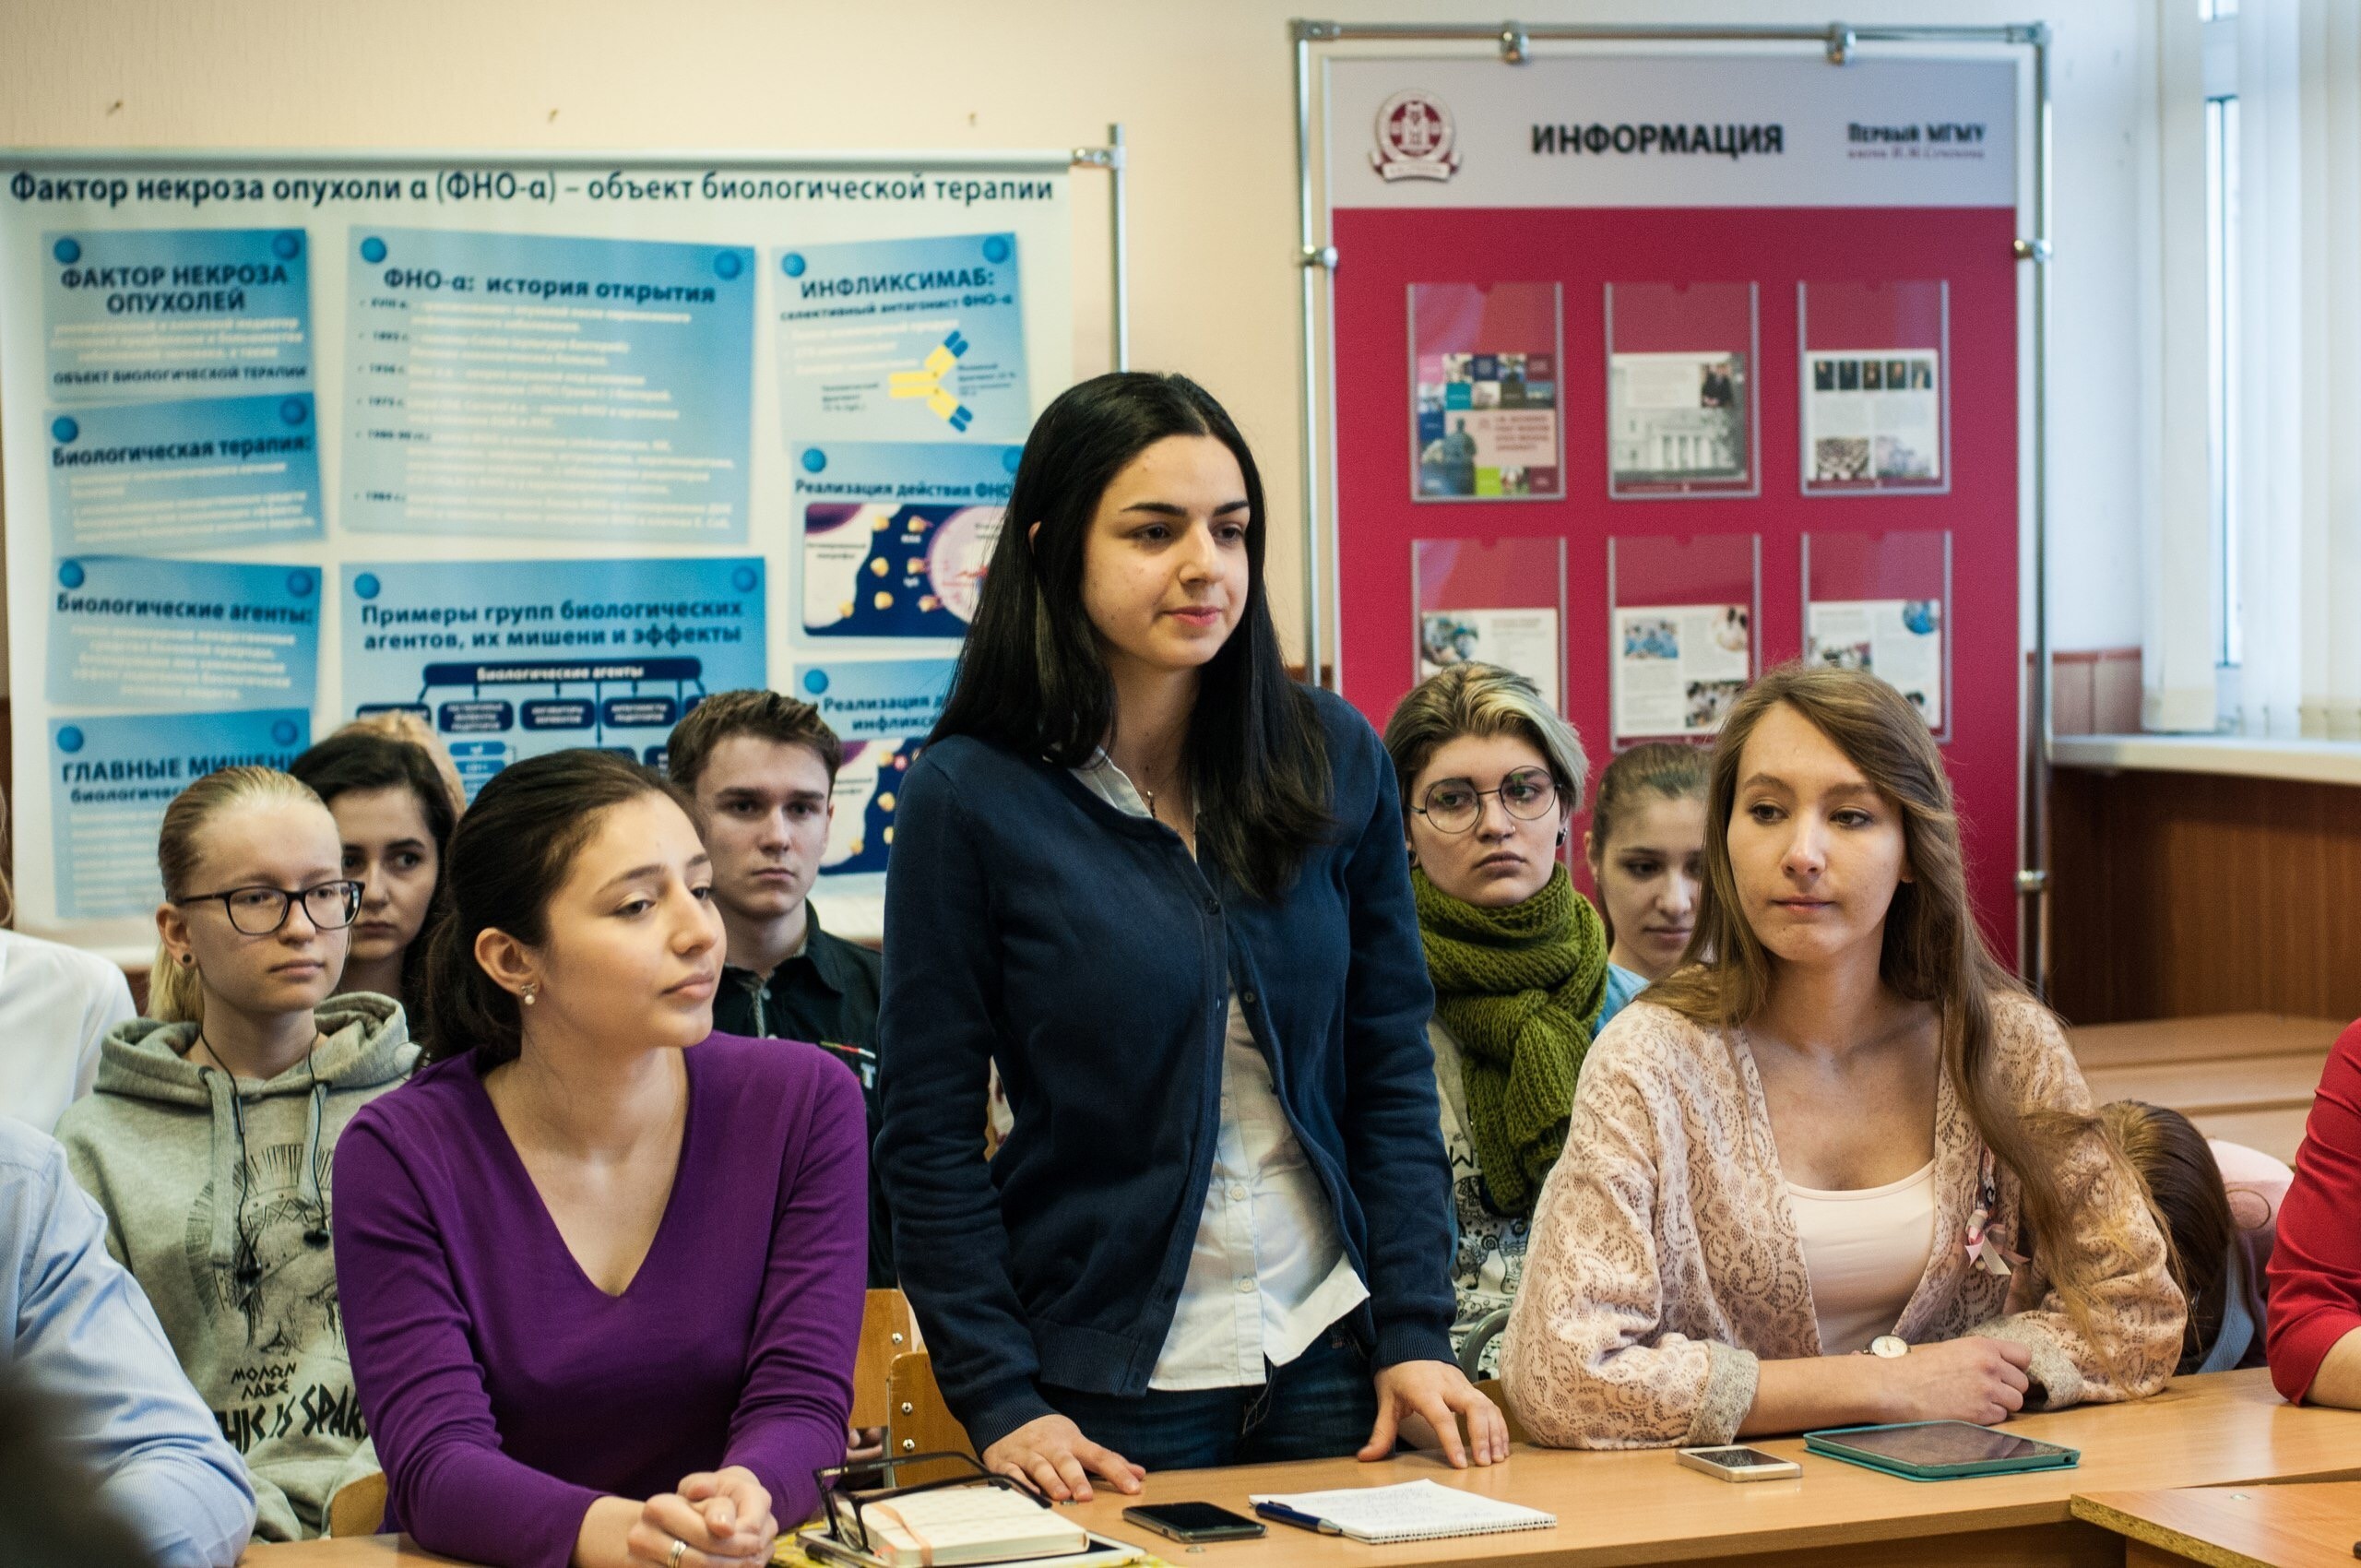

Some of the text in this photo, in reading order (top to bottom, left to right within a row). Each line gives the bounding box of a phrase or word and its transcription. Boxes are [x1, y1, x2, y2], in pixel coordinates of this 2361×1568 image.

[1532, 125, 1785, 159] ИНФОРМАЦИЯ
[1927, 122, 1986, 143] МГМУ
[10, 172, 127, 208] Фактор
[136, 178, 264, 208] некроза
[272, 175, 402, 208] опухоли
[587, 172, 693, 201] объект
[702, 172, 925, 202] биологической
[936, 179, 1053, 208] терапии
[61, 264, 288, 289] ФАКТОР НЕКРОЗА
[801, 268, 995, 299] ИНФЛИКСИМАБ:
[107, 288, 244, 315] ОПУХОЛЕЙ
[486, 277, 587, 300] история
[595, 282, 716, 304] открытия
[781, 304, 875, 321] селективный
[881, 299, 958, 314] антагонист
[53, 437, 312, 467] Биологическая терапия:
[795, 479, 893, 497] Реализация
[896, 480, 973, 498] действия
[56, 593, 313, 624] Биологические агенты:
[362, 599, 743, 628] Примеры групп биологических
[364, 624, 742, 651] агентов, их мишени и эффекты
[824, 696, 930, 711] Реализация
[62, 760, 181, 783] ГЛАВНЫЕ
[268, 1395, 296, 1439] IS
